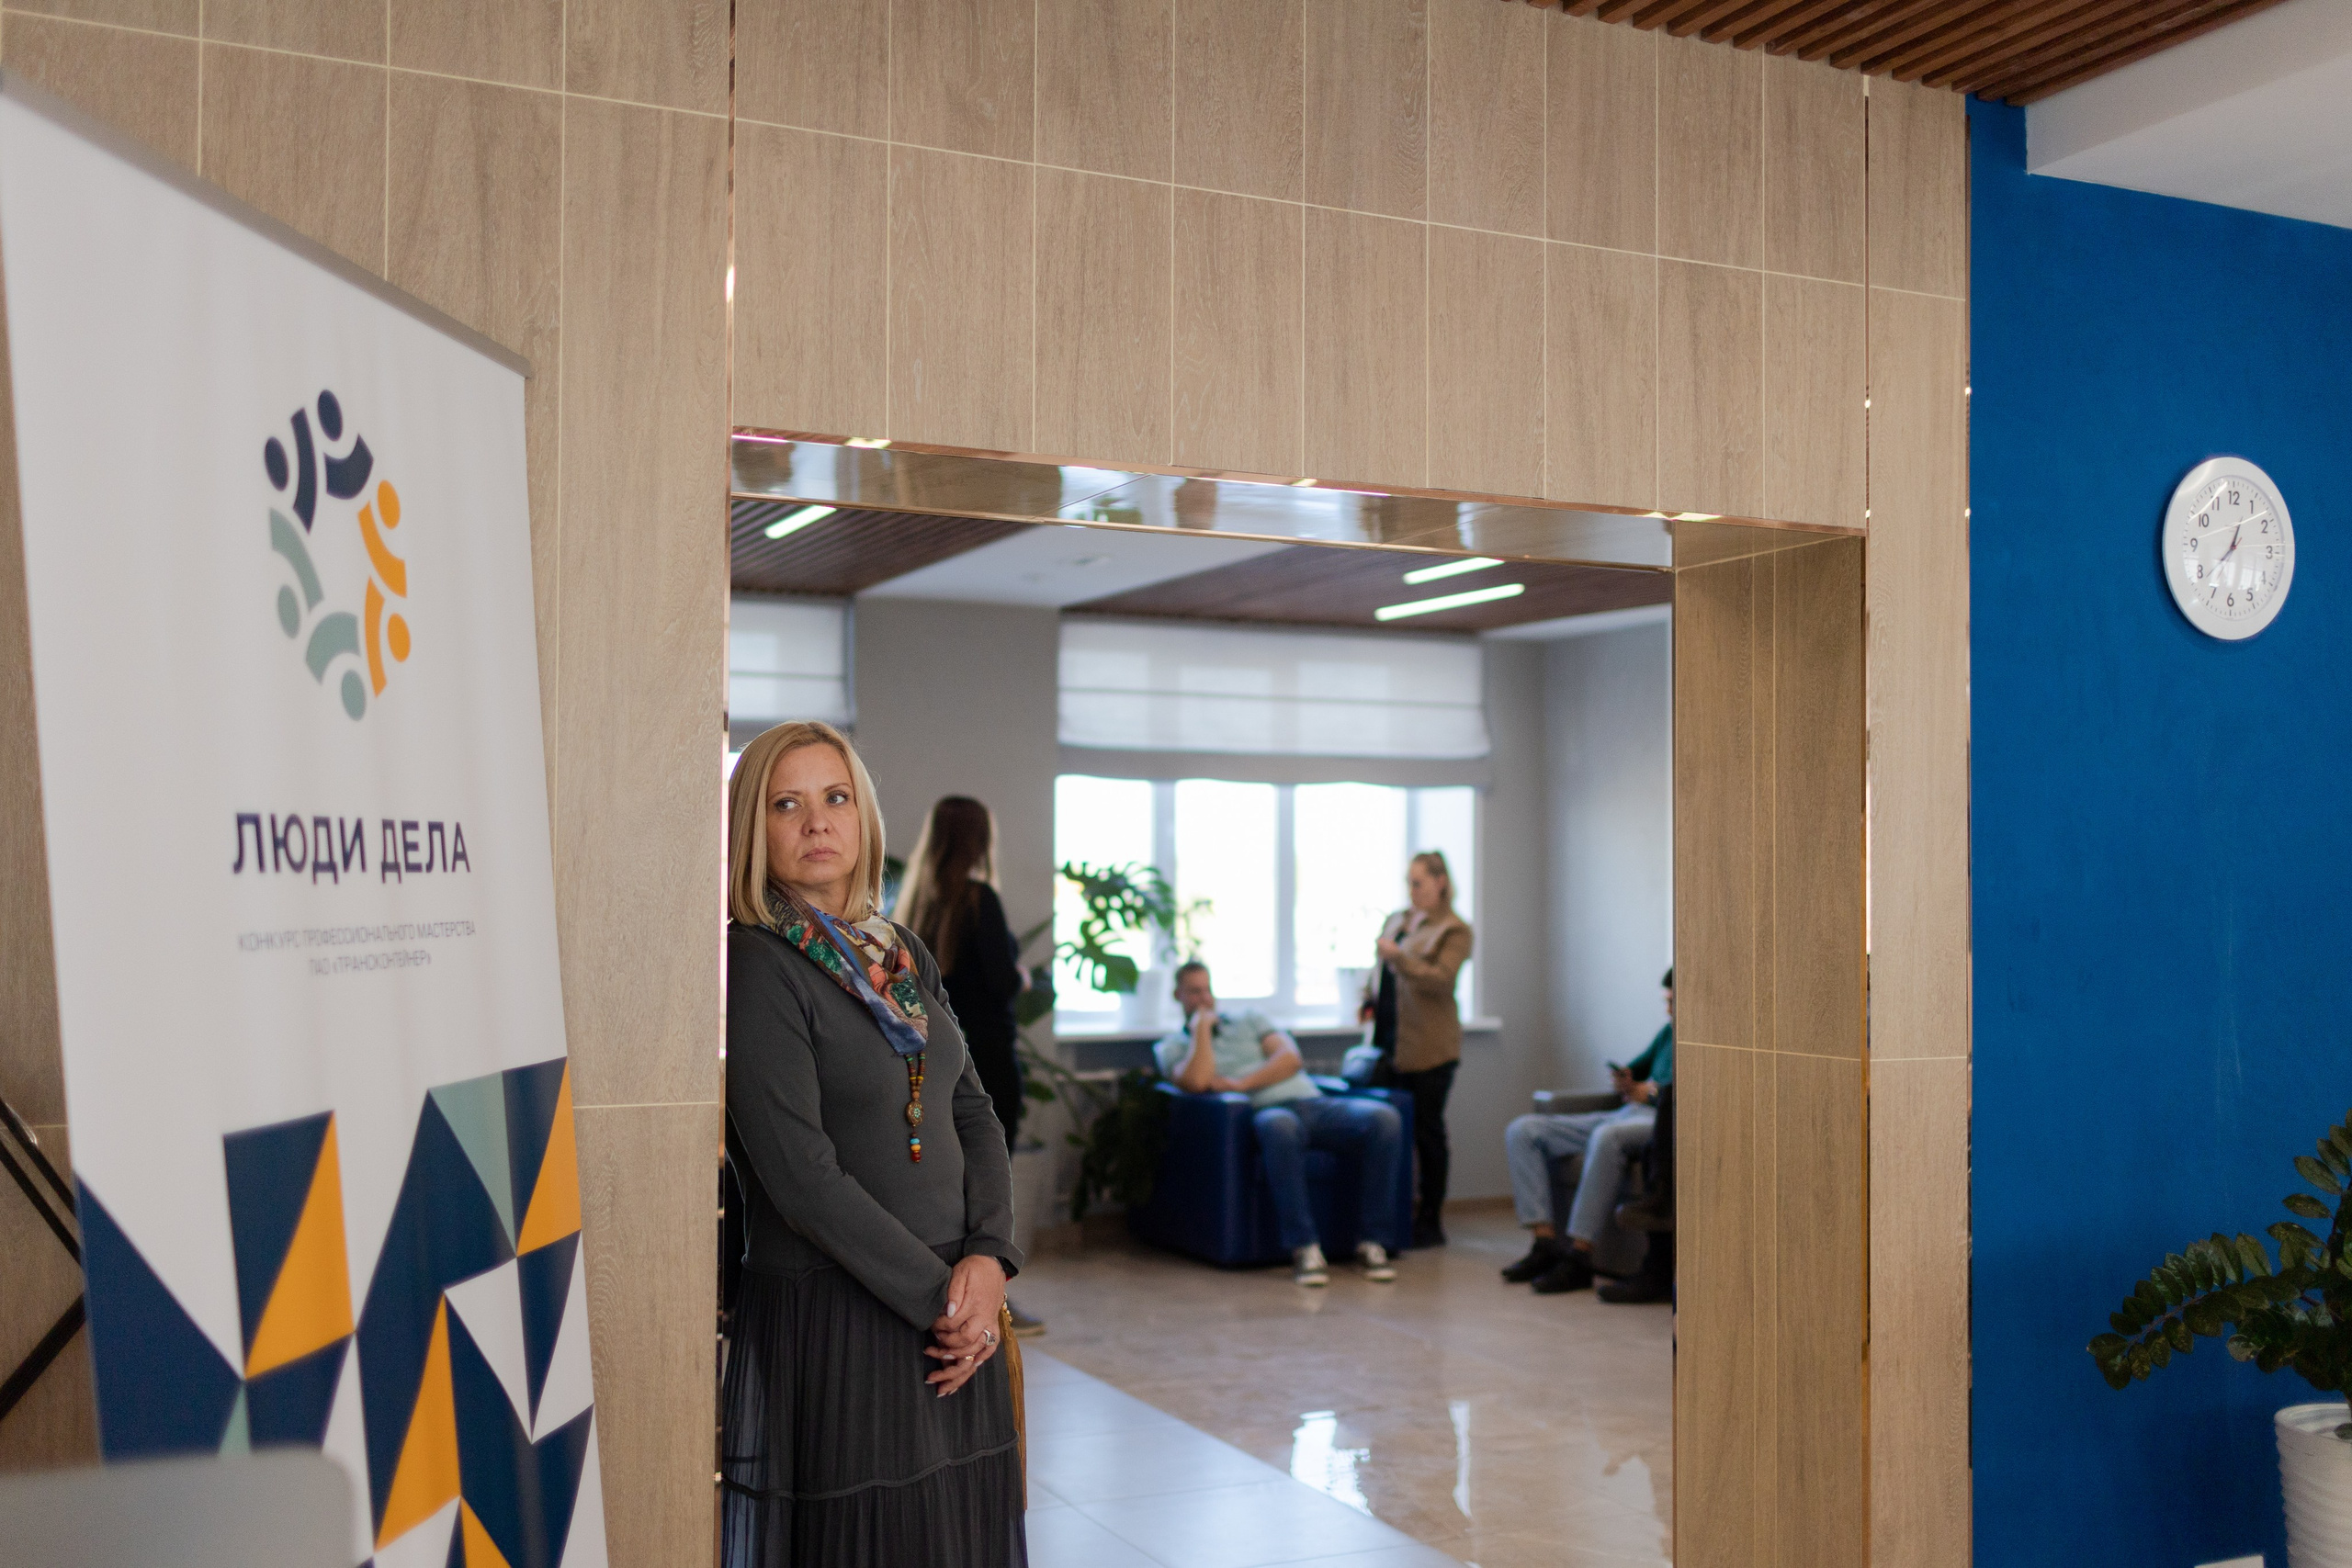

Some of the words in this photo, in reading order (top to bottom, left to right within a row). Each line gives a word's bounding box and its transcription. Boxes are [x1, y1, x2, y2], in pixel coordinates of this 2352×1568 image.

[2211, 496, 2220, 511] 11
[2228, 491, 2240, 505] 12
[2199, 513, 2210, 527] 10
[2261, 520, 2268, 534] 2
[2190, 538, 2199, 551] 9
[2266, 546, 2273, 559] 3
[2197, 565, 2203, 579] 8
[2261, 570, 2267, 584] 4
[2211, 586, 2217, 598] 7
[2246, 588, 2254, 602] 5
[2227, 592, 2234, 607] 6
[233, 812, 367, 886] ЛЮДИ
[380, 818, 471, 885] ДЕЛА
[239, 930, 300, 952] КОНКУРС
[302, 924, 414, 947] ПРОФЕССИОНАЛЬНОГО
[416, 920, 476, 939] МАСТЕРСТВА
